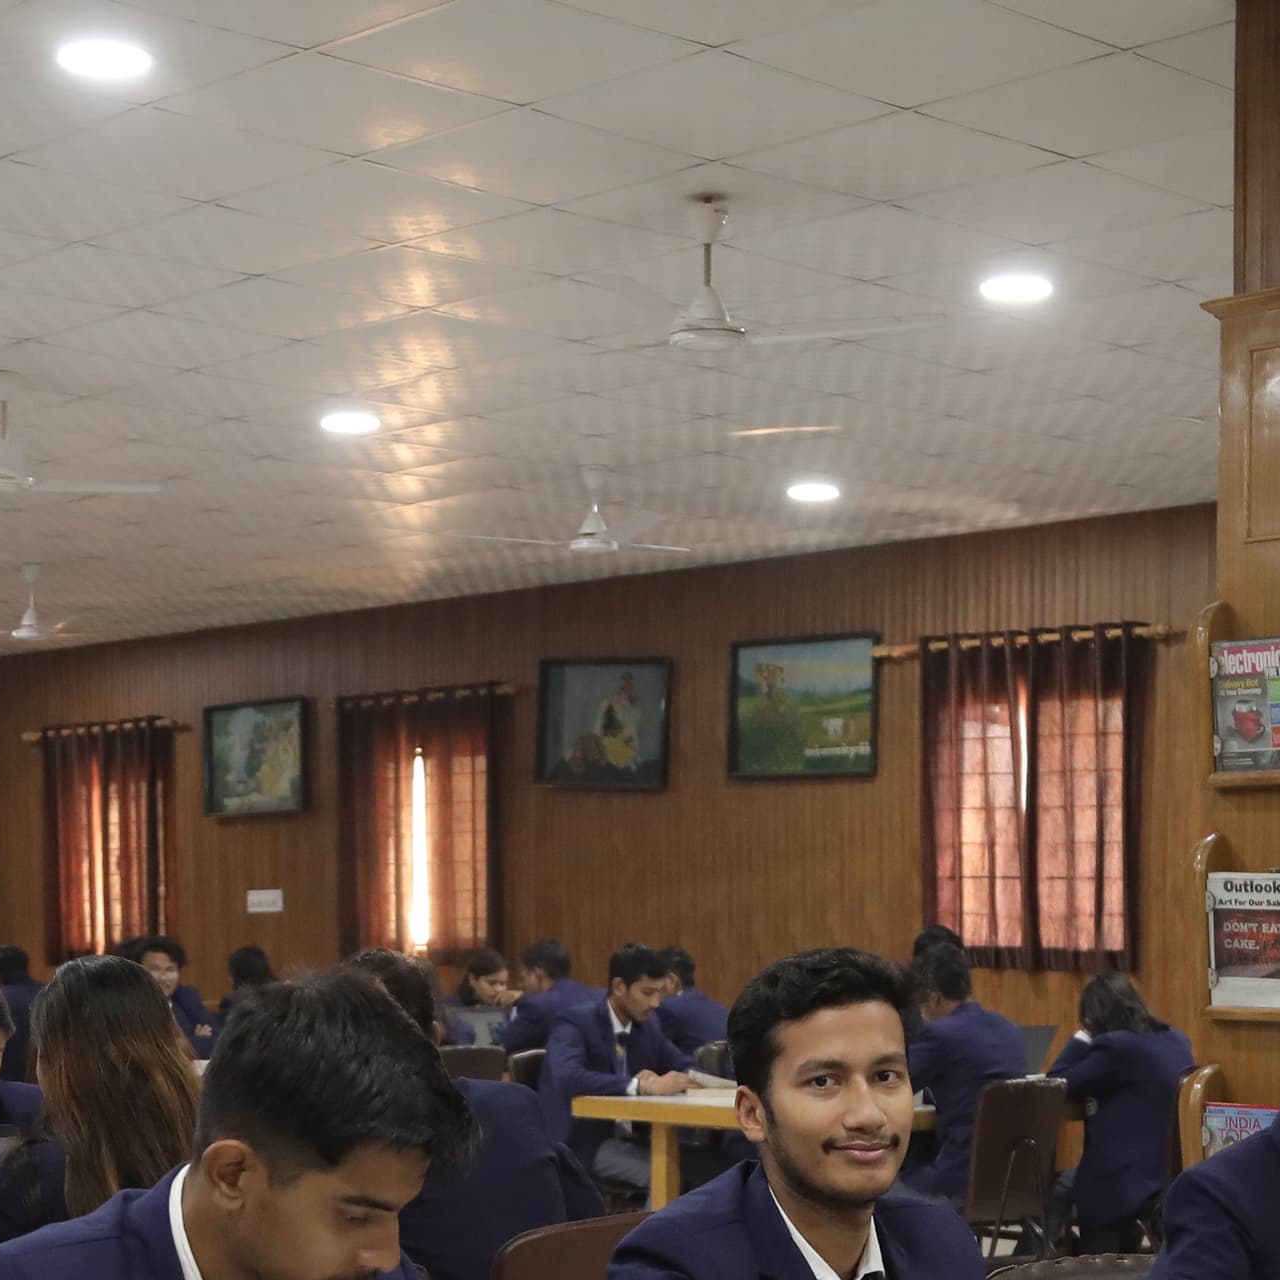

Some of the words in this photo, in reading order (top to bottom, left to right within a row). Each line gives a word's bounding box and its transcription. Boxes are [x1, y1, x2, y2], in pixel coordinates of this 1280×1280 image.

[1218, 898, 1233, 906] Art
[1234, 899, 1247, 907] For
[1248, 899, 1263, 907] Our
[1223, 922, 1259, 932] DON'T
[1225, 1116, 1261, 1129] INDIA
